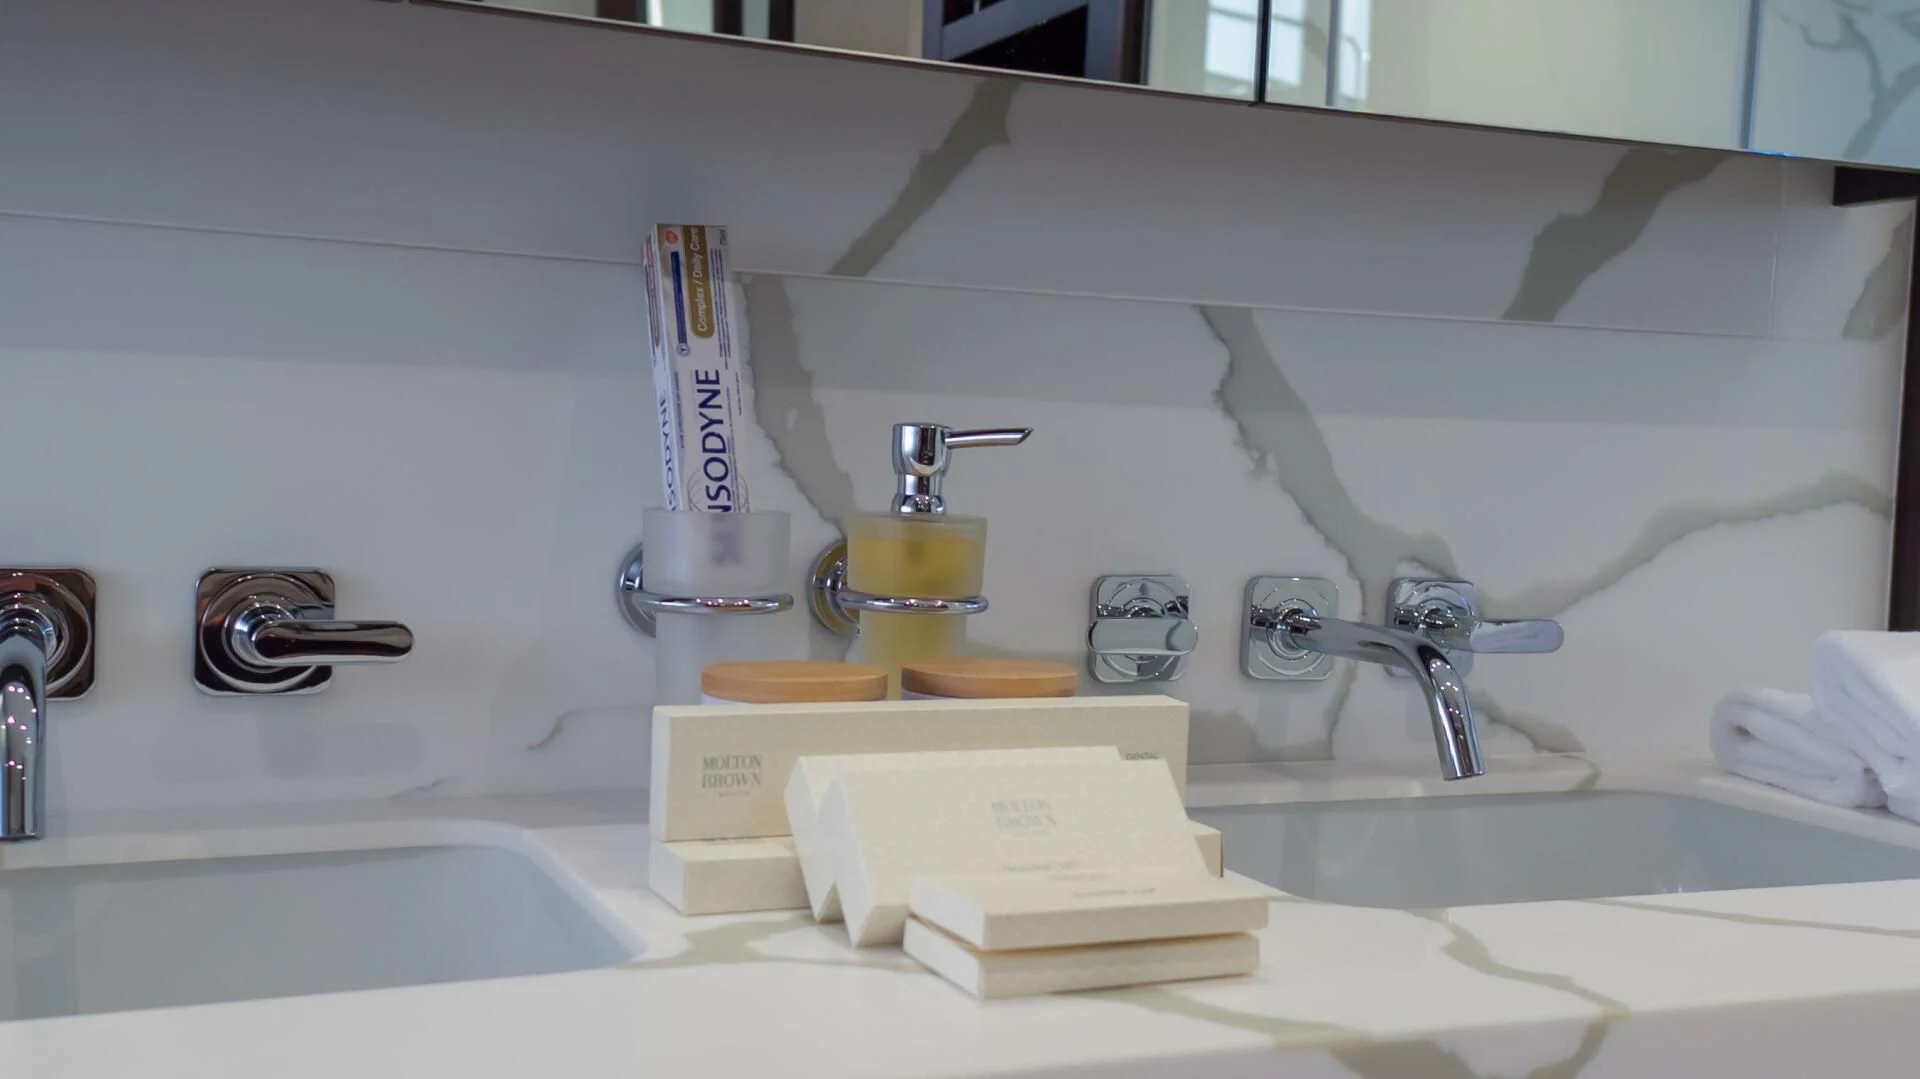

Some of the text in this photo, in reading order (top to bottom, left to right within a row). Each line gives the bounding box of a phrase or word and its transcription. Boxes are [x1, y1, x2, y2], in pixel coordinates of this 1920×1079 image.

[690, 227, 700, 251] Care
[691, 253, 703, 278] Daily
[695, 287, 708, 332] Complex
[702, 755, 761, 770] MOLTON
[702, 772, 761, 788] BROWN
